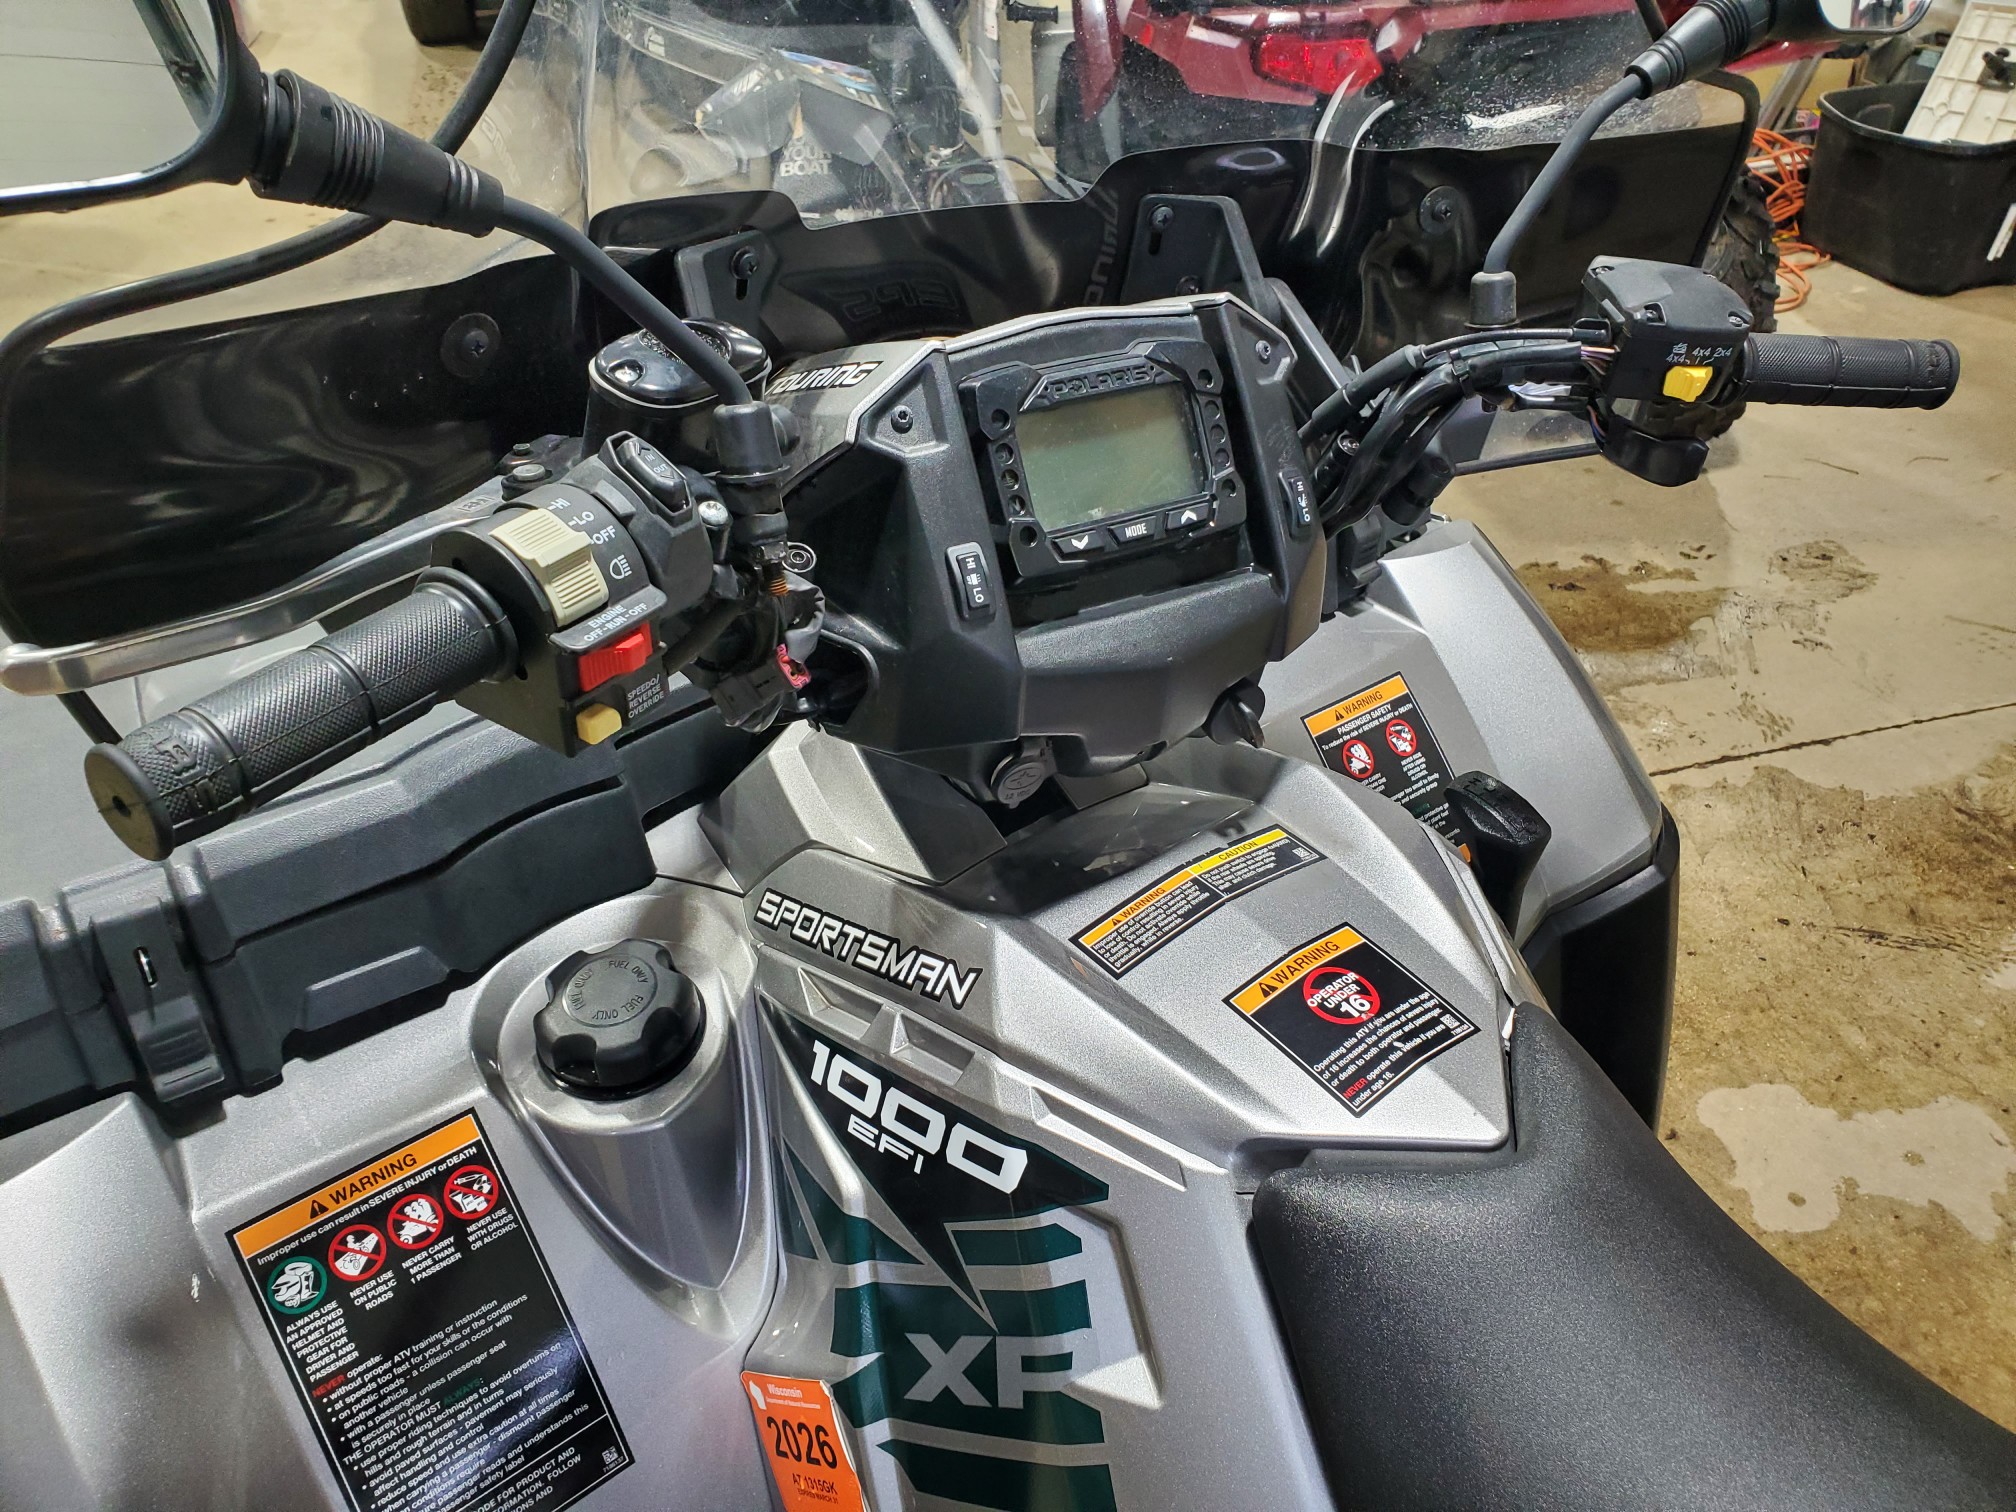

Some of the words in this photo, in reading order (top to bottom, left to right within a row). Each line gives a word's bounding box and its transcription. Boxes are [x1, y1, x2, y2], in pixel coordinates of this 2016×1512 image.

[780, 160, 831, 176] BOAT
[1666, 354, 1686, 363] 4x4
[1692, 347, 1712, 357] 4x4
[1713, 347, 1733, 357] 2x4
[764, 363, 880, 395] TOURING
[1050, 365, 1150, 399] POLARIS
[653, 463, 668, 473] OUT
[1296, 481, 1304, 492] HI
[551, 498, 571, 509] HI
[573, 511, 594, 525] LO
[1302, 508, 1310, 522] LO
[592, 525, 616, 545] OFF
[1124, 523, 1147, 538] MODE
[965, 557, 977, 570] HI
[972, 587, 984, 603] LO
[588, 604, 627, 629] ENGINE
[627, 673, 660, 701] SPEEDO/
[629, 684, 662, 709] REVERSE
[628, 691, 665, 719] OVERRIDE
[1342, 690, 1383, 715] WARNING
[1336, 713, 1371, 734] PASSENGER
[1370, 703, 1391, 718] SAFETY
[1217, 840, 1258, 860] CAUTION
[1118, 887, 1166, 918] WARNING
[757, 896, 976, 1006] SPORTSMAN
[1269, 941, 1340, 984] WARNING
[608, 960, 630, 970] FUEL
[631, 965, 649, 984] ONLY
[1306, 971, 1359, 1006] OPERATOR
[1323, 983, 1360, 1008] UNDER
[620, 994, 644, 1013] FUEL
[1339, 994, 1370, 1017] 16
[1313, 1045, 1346, 1071] Operating
[1342, 1036, 1357, 1048] this
[1355, 1025, 1369, 1039] ATV
[1383, 1010, 1395, 1019] are
[1393, 1001, 1410, 1013] under
[1407, 997, 1420, 1005] the
[1322, 1069, 1331, 1079] of
[1328, 1063, 1339, 1073] 16
[1335, 1042, 1367, 1067] increases
[1364, 1034, 1377, 1044] the
[1376, 1019, 1401, 1036] chances
[1399, 1014, 1407, 1022] of
[1330, 1077, 1339, 1086] or
[1338, 1063, 1358, 1080] death
[1354, 1058, 1365, 1066] to
[1361, 1046, 1379, 1060] both
[1377, 1028, 1403, 1048] operator
[1402, 1021, 1415, 1032] and
[1343, 1078, 1366, 1097] NEVER
[1366, 1059, 1391, 1080] operate
[1387, 1049, 1403, 1061] this
[1424, 1028, 1437, 1038] you
[1434, 1023, 1445, 1032] are
[1352, 1088, 1371, 1106] under
[1370, 1079, 1384, 1091] age
[810, 1040, 1028, 1194] 1000
[847, 1115, 924, 1175] EFI
[328, 1153, 417, 1204] WARNING
[257, 1239, 299, 1265] Improper
[299, 1231, 317, 1243] use
[317, 1221, 334, 1233] can
[334, 1207, 360, 1225] result
[359, 1203, 369, 1212] in
[368, 1183, 405, 1207] SEVERE
[403, 1165, 436, 1188] INJURY
[437, 1162, 447, 1171] or
[445, 1145, 477, 1166] DEATH
[466, 1215, 491, 1233] NEVER
[491, 1207, 507, 1219] USE
[466, 1227, 487, 1242] WITH
[487, 1213, 513, 1231] DRUGS
[470, 1240, 483, 1250] OR
[483, 1221, 518, 1244] ALCOHOL
[401, 1250, 428, 1268] NEVER
[428, 1235, 453, 1254] CARRY
[409, 1257, 433, 1274] MORE
[432, 1245, 454, 1260] THAN
[415, 1252, 462, 1281] PASSENGER
[349, 1279, 377, 1298] NEVER
[376, 1269, 394, 1283] USE
[353, 1294, 367, 1305] ON
[367, 1278, 396, 1298] PUBLIC
[364, 1290, 393, 1310] ROADS
[286, 1309, 320, 1333] ALWAYS
[320, 1300, 338, 1313] USE
[286, 1331, 298, 1343] AN
[299, 1307, 343, 1336] APPROVED
[291, 1327, 324, 1350] HELMET
[327, 1317, 344, 1331] AND
[296, 1325, 348, 1358] PROTECTIVE
[305, 1352, 337, 1374] DRIVER
[337, 1342, 355, 1356] AND
[306, 1346, 330, 1362] GEAR
[329, 1336, 348, 1350] FOR
[329, 1376, 362, 1400] without
[363, 1359, 391, 1382] proper
[393, 1347, 410, 1363] ATV
[411, 1330, 444, 1352] training
[444, 1324, 453, 1333] or
[454, 1299, 497, 1327] instruction
[309, 1350, 359, 1382] PASSENGER
[313, 1375, 344, 1395] NEVER
[346, 1353, 383, 1378] operate:
[904, 1332, 1096, 1409] XP
[766, 1383, 802, 1397] Wisconsin
[343, 1405, 376, 1429] another
[377, 1387, 408, 1408] vehicle
[342, 1448, 363, 1464] THE
[363, 1418, 414, 1452] OPERATOR
[415, 1400, 440, 1422] MUST
[766, 1415, 837, 1468] 2026
[803, 1475, 838, 1495] 1315GK
